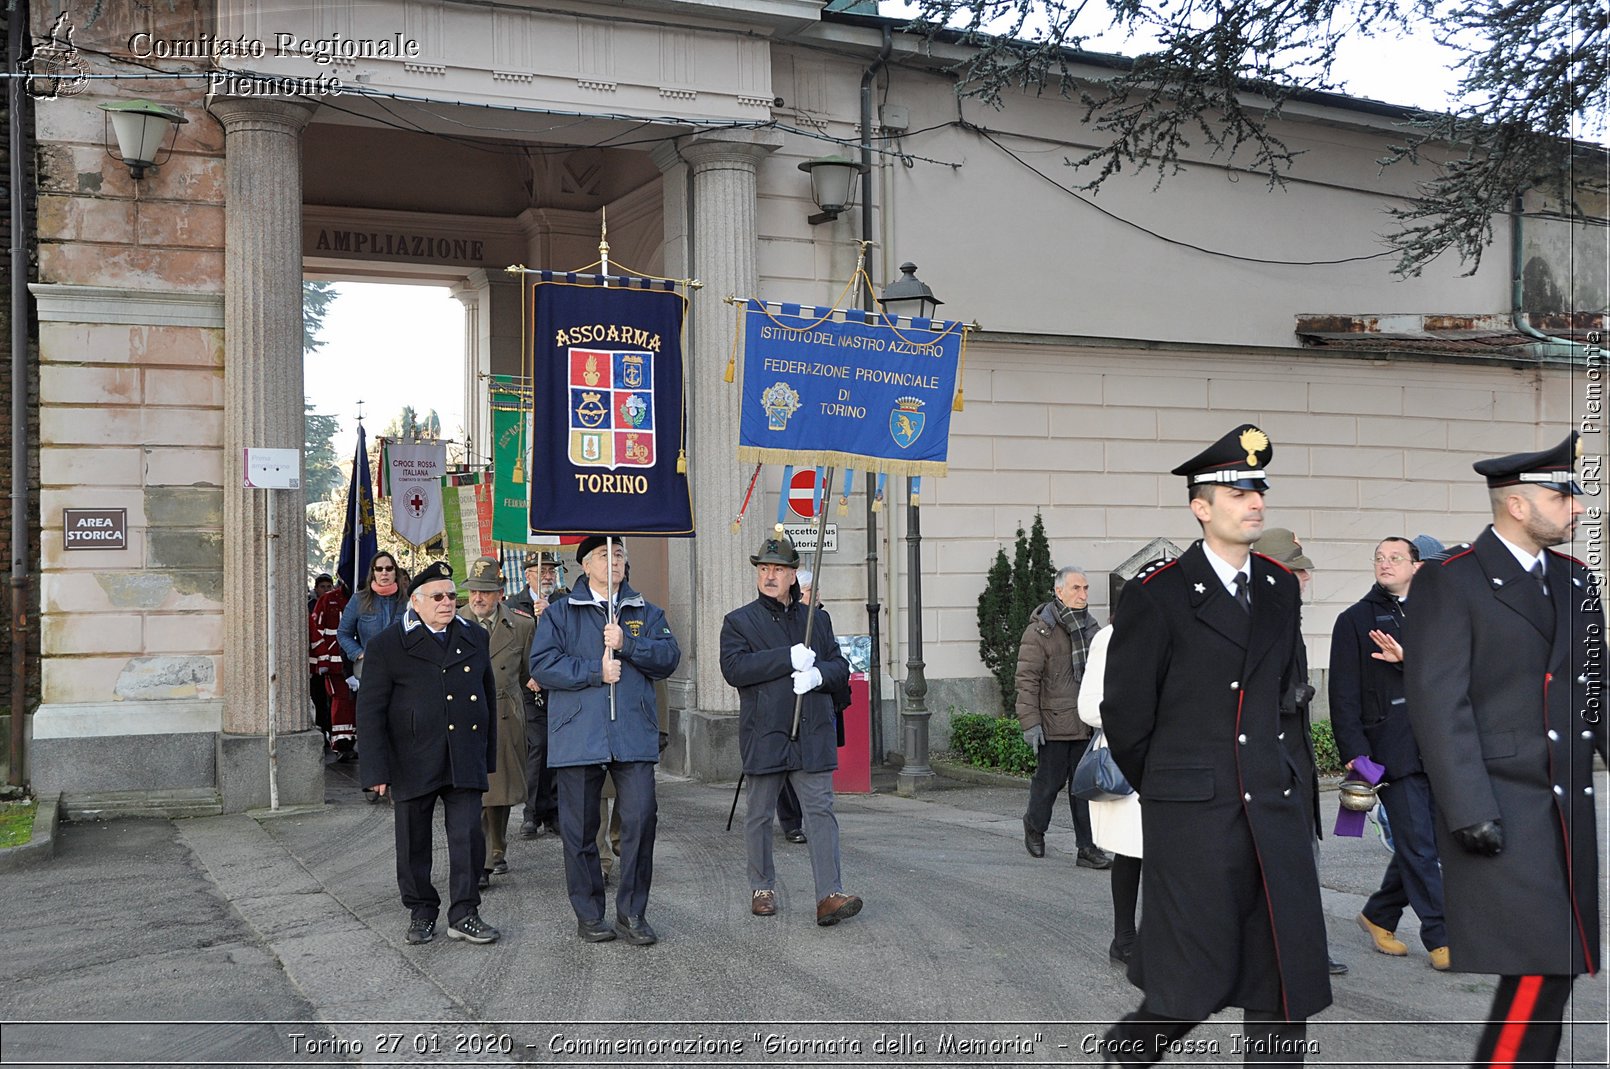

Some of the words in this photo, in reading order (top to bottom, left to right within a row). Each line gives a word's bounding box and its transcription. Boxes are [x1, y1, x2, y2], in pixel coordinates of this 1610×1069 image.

[316, 229, 484, 261] AMPLIAZIONE
[556, 324, 661, 352] ASSOARMA
[760, 326, 813, 343] ISTITUTO
[813, 331, 836, 347] DEL
[837, 335, 886, 352] NASTRO
[888, 340, 944, 358] AZZURRO
[764, 358, 851, 379] FEDERAZIONE
[855, 367, 940, 389] PROVINCIALE
[838, 388, 851, 401] DI
[820, 402, 867, 419] TORINO
[393, 459, 415, 467] CROCE
[417, 460, 437, 468] ROSSA
[575, 473, 648, 494] TORINO
[77, 518, 113, 527] AREA
[68, 530, 123, 540] STORICA
[794, 540, 833, 548] utorizati
